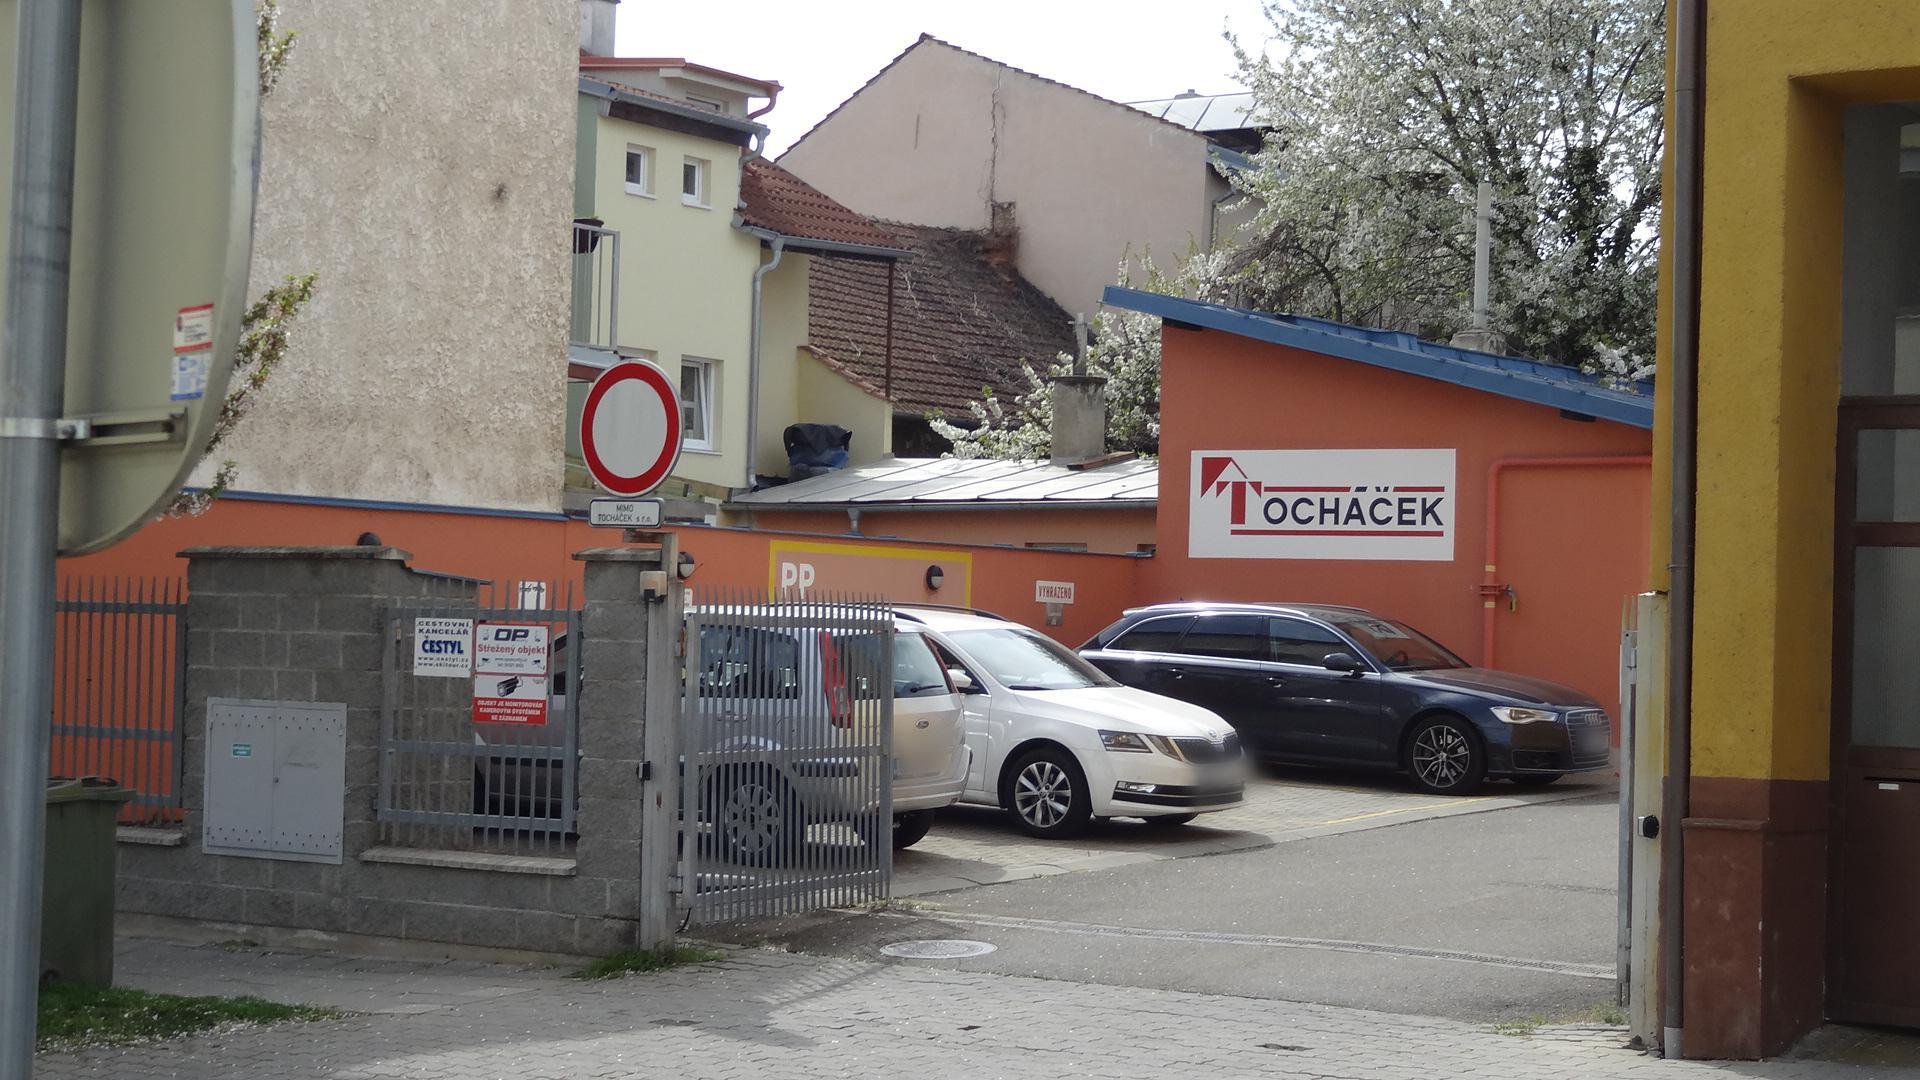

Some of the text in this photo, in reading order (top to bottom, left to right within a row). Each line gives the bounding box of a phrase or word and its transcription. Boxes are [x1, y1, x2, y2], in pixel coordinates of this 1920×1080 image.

[616, 504, 634, 512] MIMO
[1215, 481, 1445, 526] TOCHÁČEK
[598, 512, 633, 522] TOCHÁČEK
[1039, 585, 1072, 599] VYHRAZENO
[418, 620, 469, 628] CESTOVNÍ
[418, 628, 469, 636] KANCELÁŘ
[494, 628, 530, 641] OP
[421, 634, 464, 655] ČESTYL
[478, 643, 546, 656] Střežený objekt
